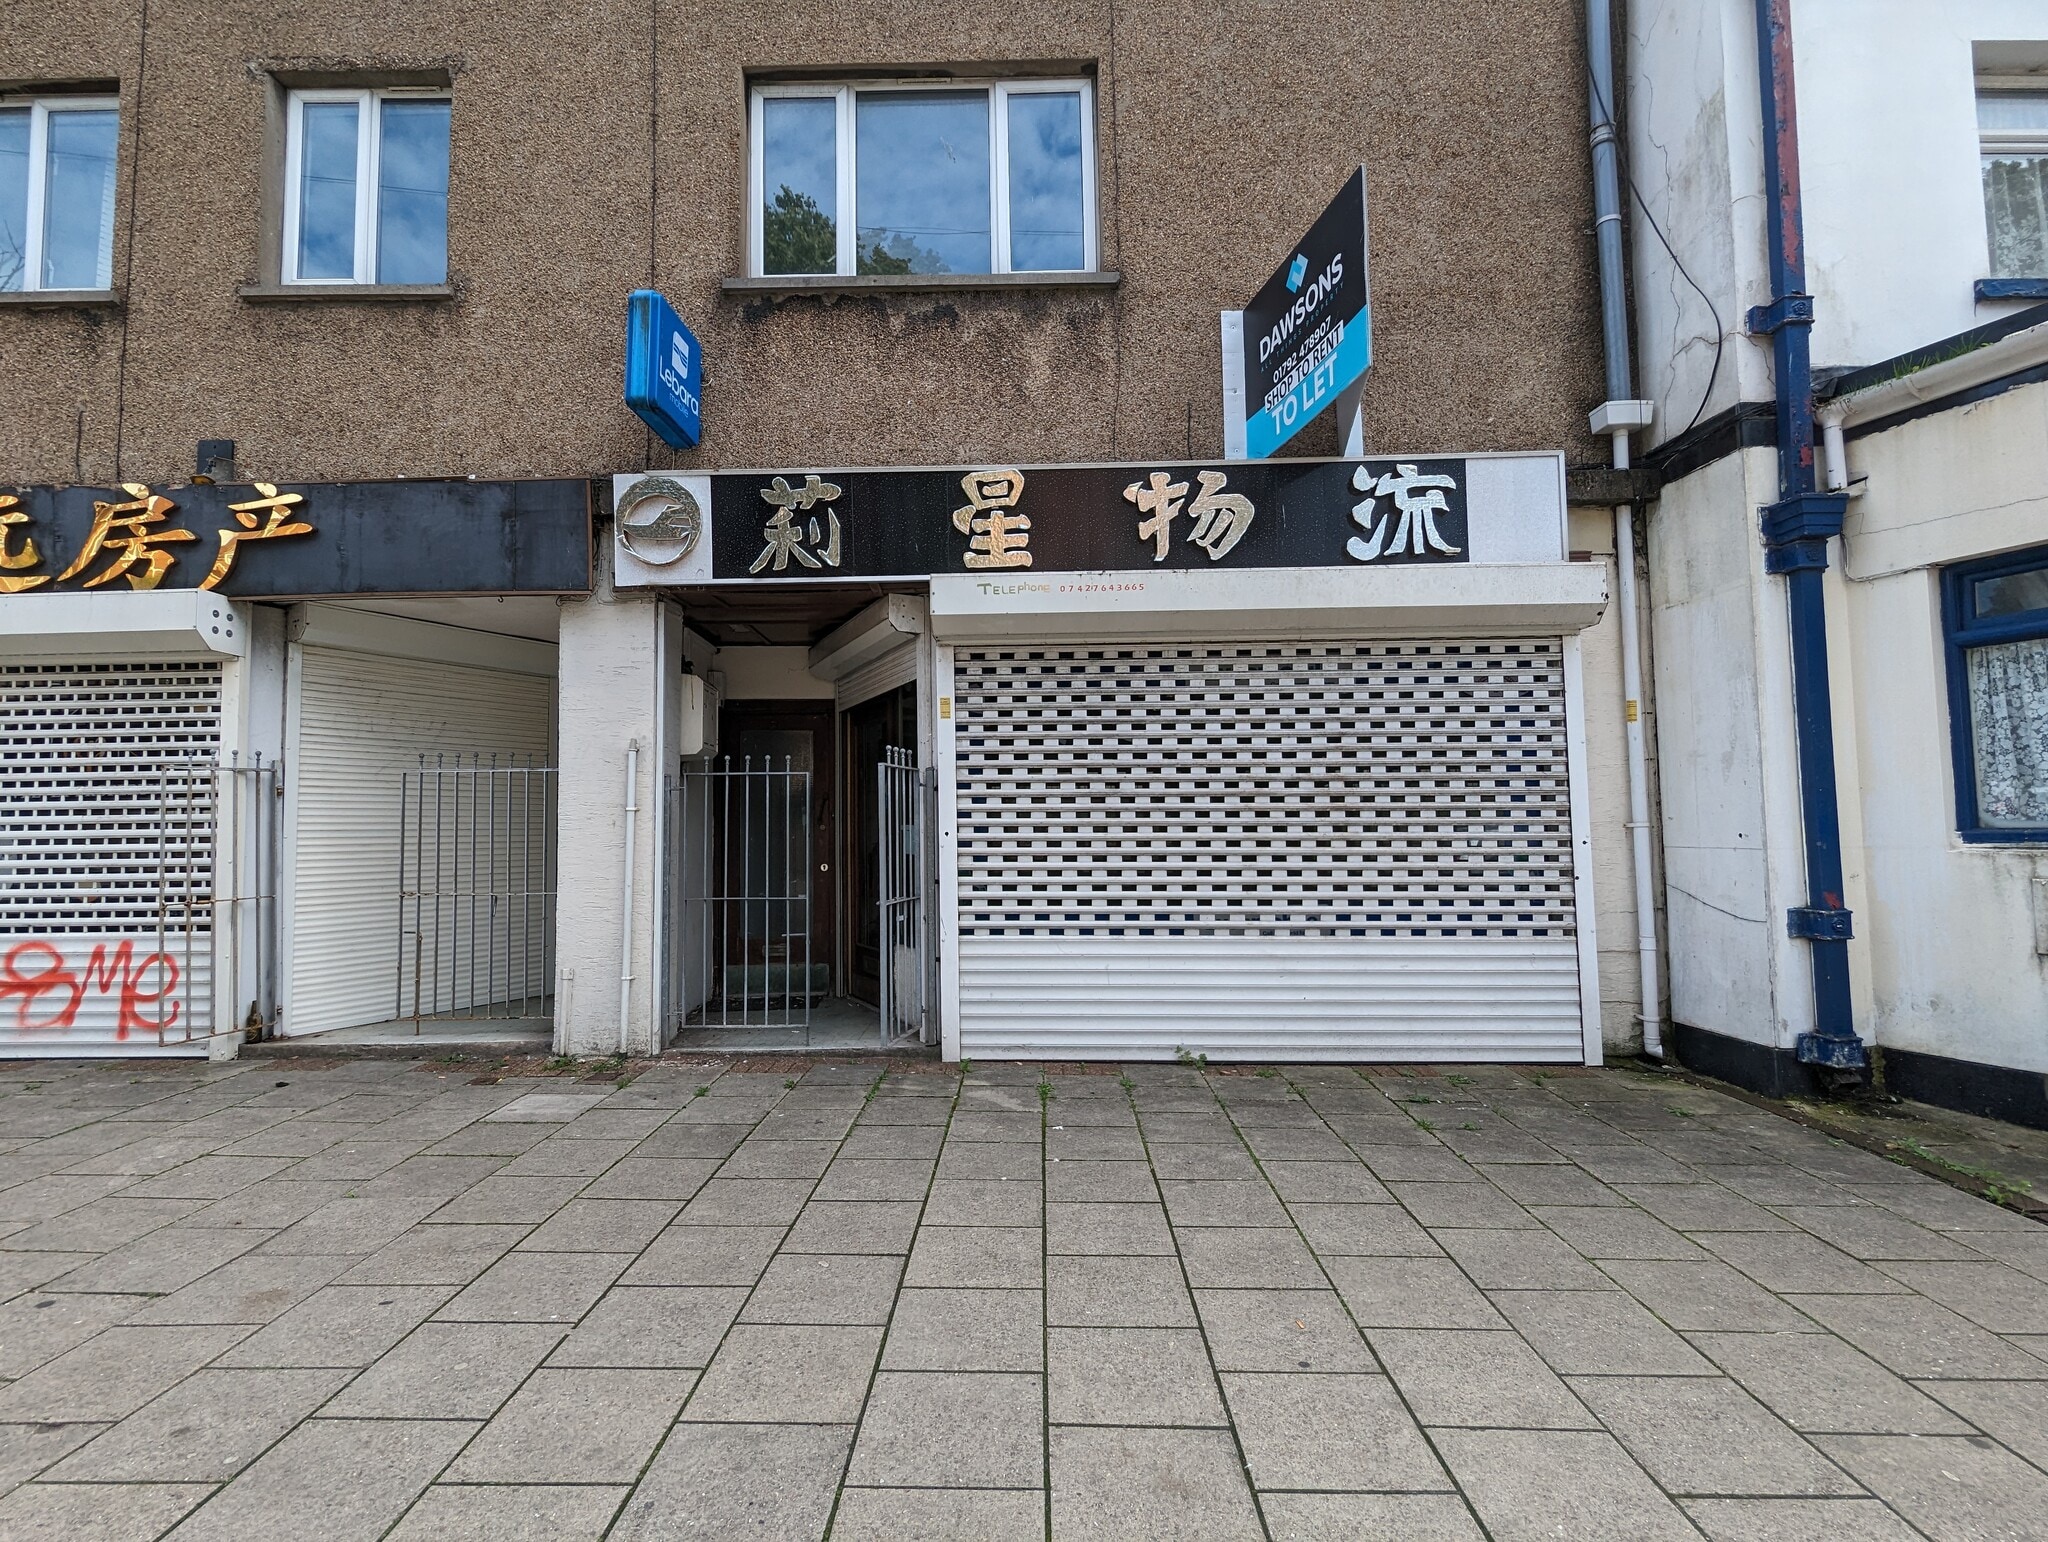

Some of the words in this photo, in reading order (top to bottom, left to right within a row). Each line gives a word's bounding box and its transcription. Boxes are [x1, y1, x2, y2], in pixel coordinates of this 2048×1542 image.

[1259, 253, 1344, 364] DAWSONS
[660, 355, 699, 417] Lebara
[1266, 375, 1293, 411] SHOP
[1296, 358, 1310, 382] TO
[1313, 325, 1341, 367] RENT
[1273, 352, 1297, 383] 01792
[1299, 315, 1331, 357] 478907
[669, 392, 689, 418] mobile
[1271, 394, 1298, 436] TO
[1302, 351, 1338, 412] LET
